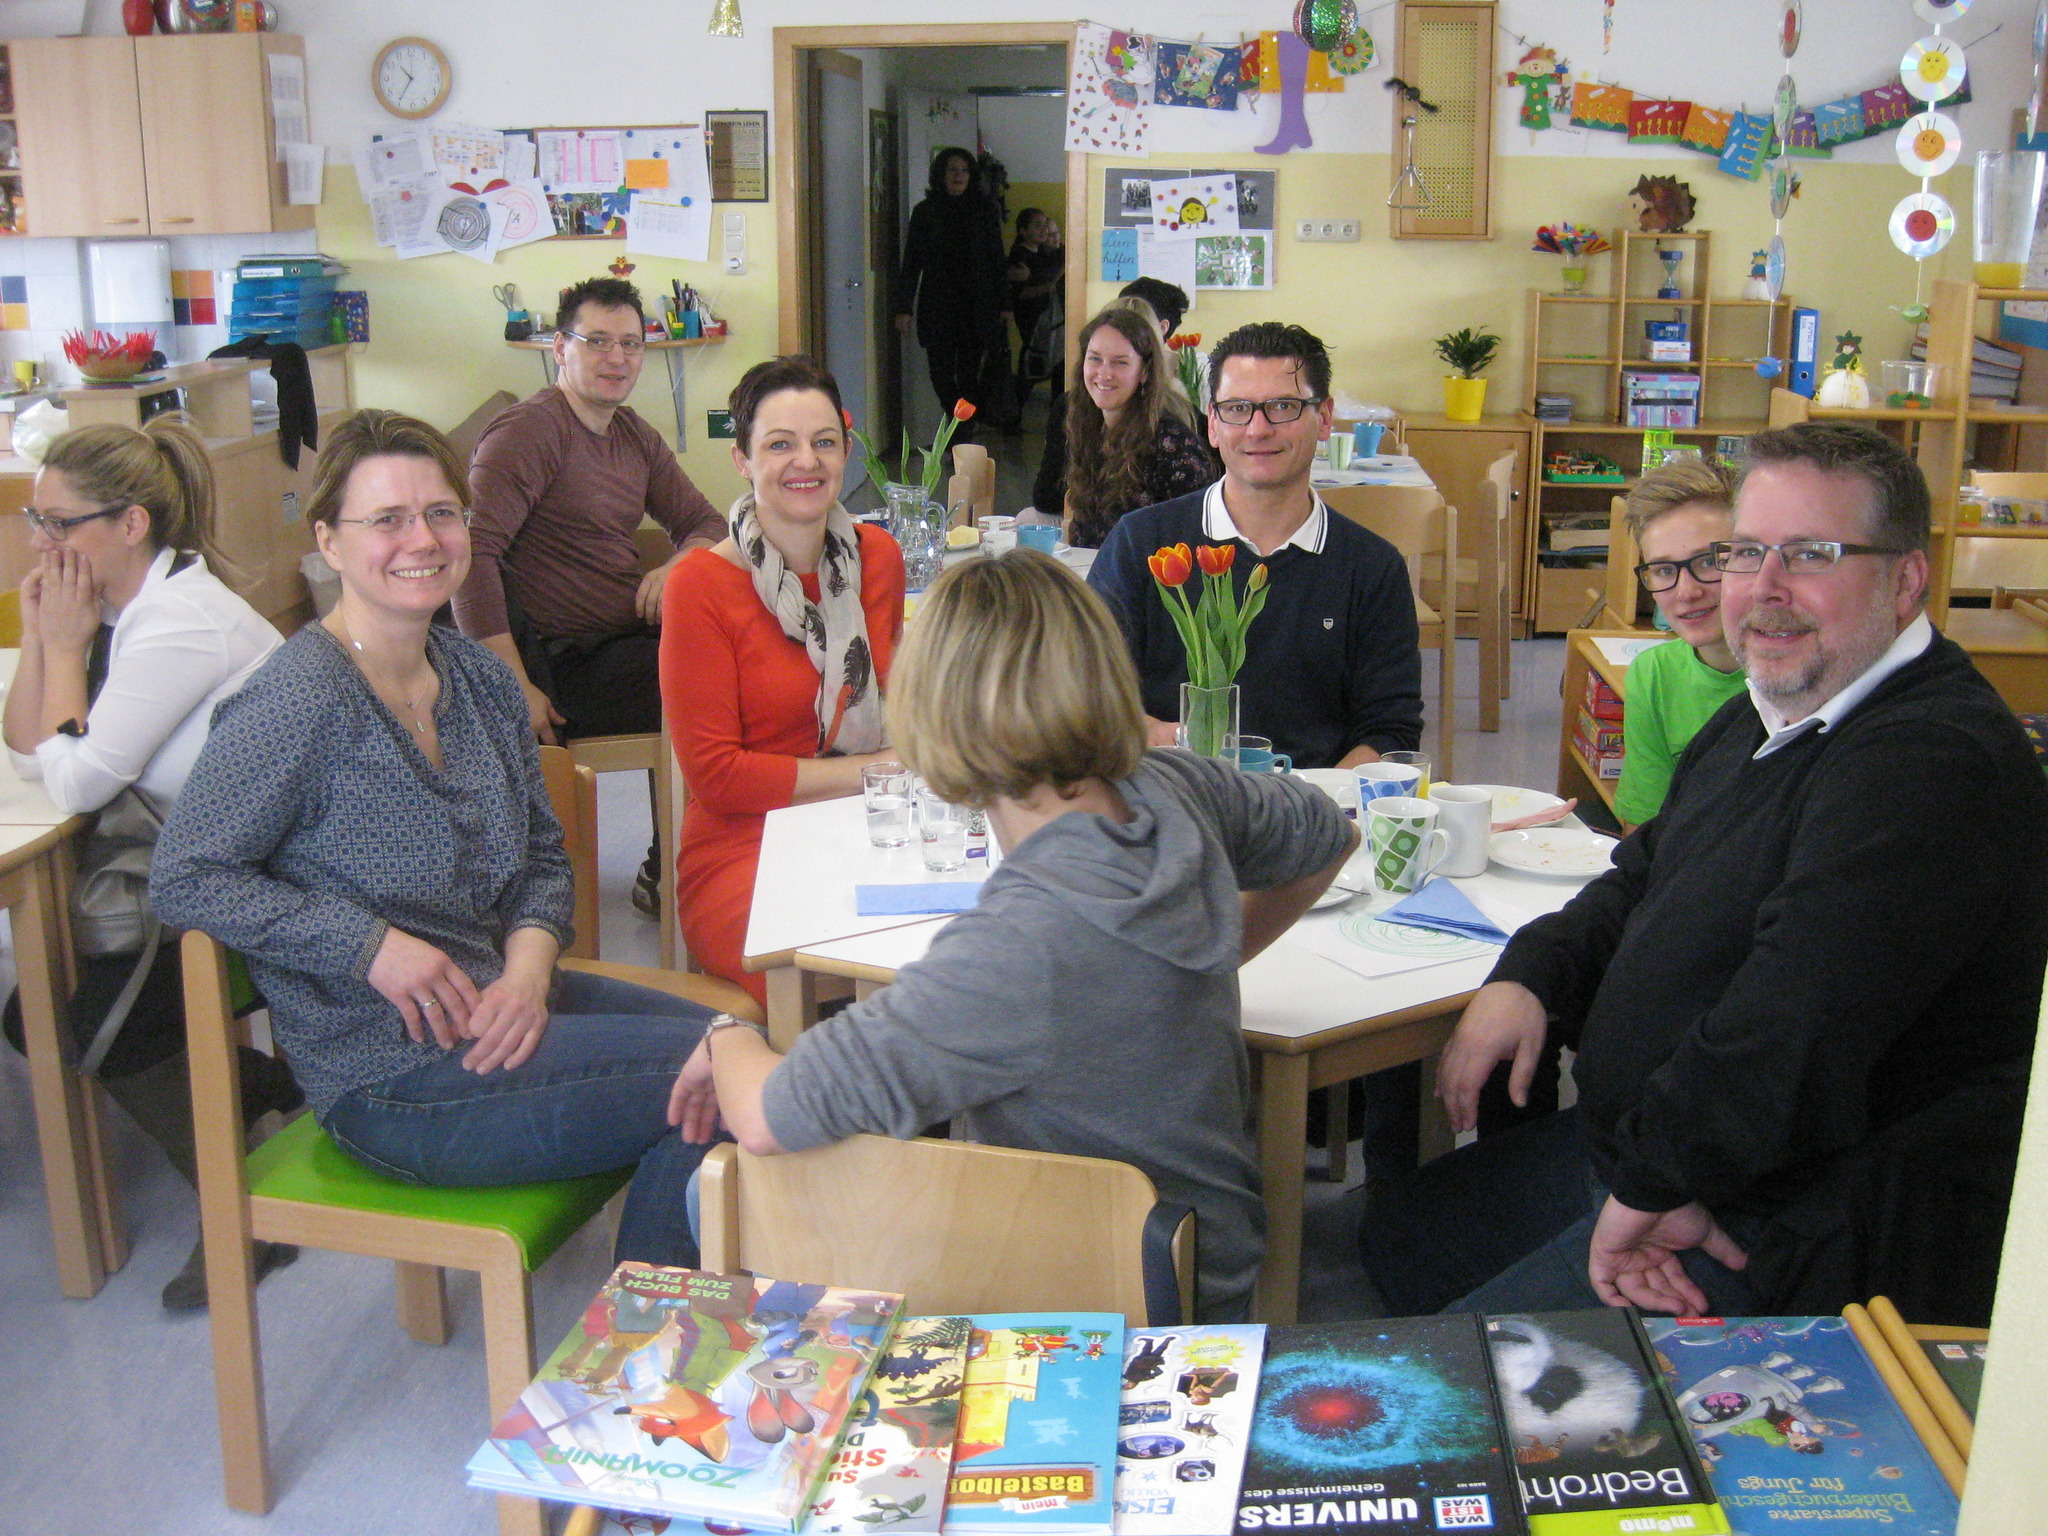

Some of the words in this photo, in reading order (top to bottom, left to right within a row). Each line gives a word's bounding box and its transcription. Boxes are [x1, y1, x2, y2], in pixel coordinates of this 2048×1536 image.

[635, 1270, 683, 1284] FILM
[686, 1277, 733, 1290] ZUM
[625, 1279, 683, 1294] BUCH
[687, 1287, 731, 1301] DAS
[543, 1443, 754, 1490] ZOOMANIA
[826, 1469, 859, 1485] Su
[1278, 1483, 1385, 1496] Geheimnisse
[1737, 1476, 1804, 1495] Jungs
[1810, 1477, 1846, 1492] für
[1243, 1487, 1274, 1498] des
[1021, 1498, 1059, 1511] Mein
[1440, 1498, 1482, 1507] WAS
[1449, 1507, 1475, 1516] IST
[1443, 1515, 1486, 1525] WAS
[1619, 1514, 1696, 1532] memo
